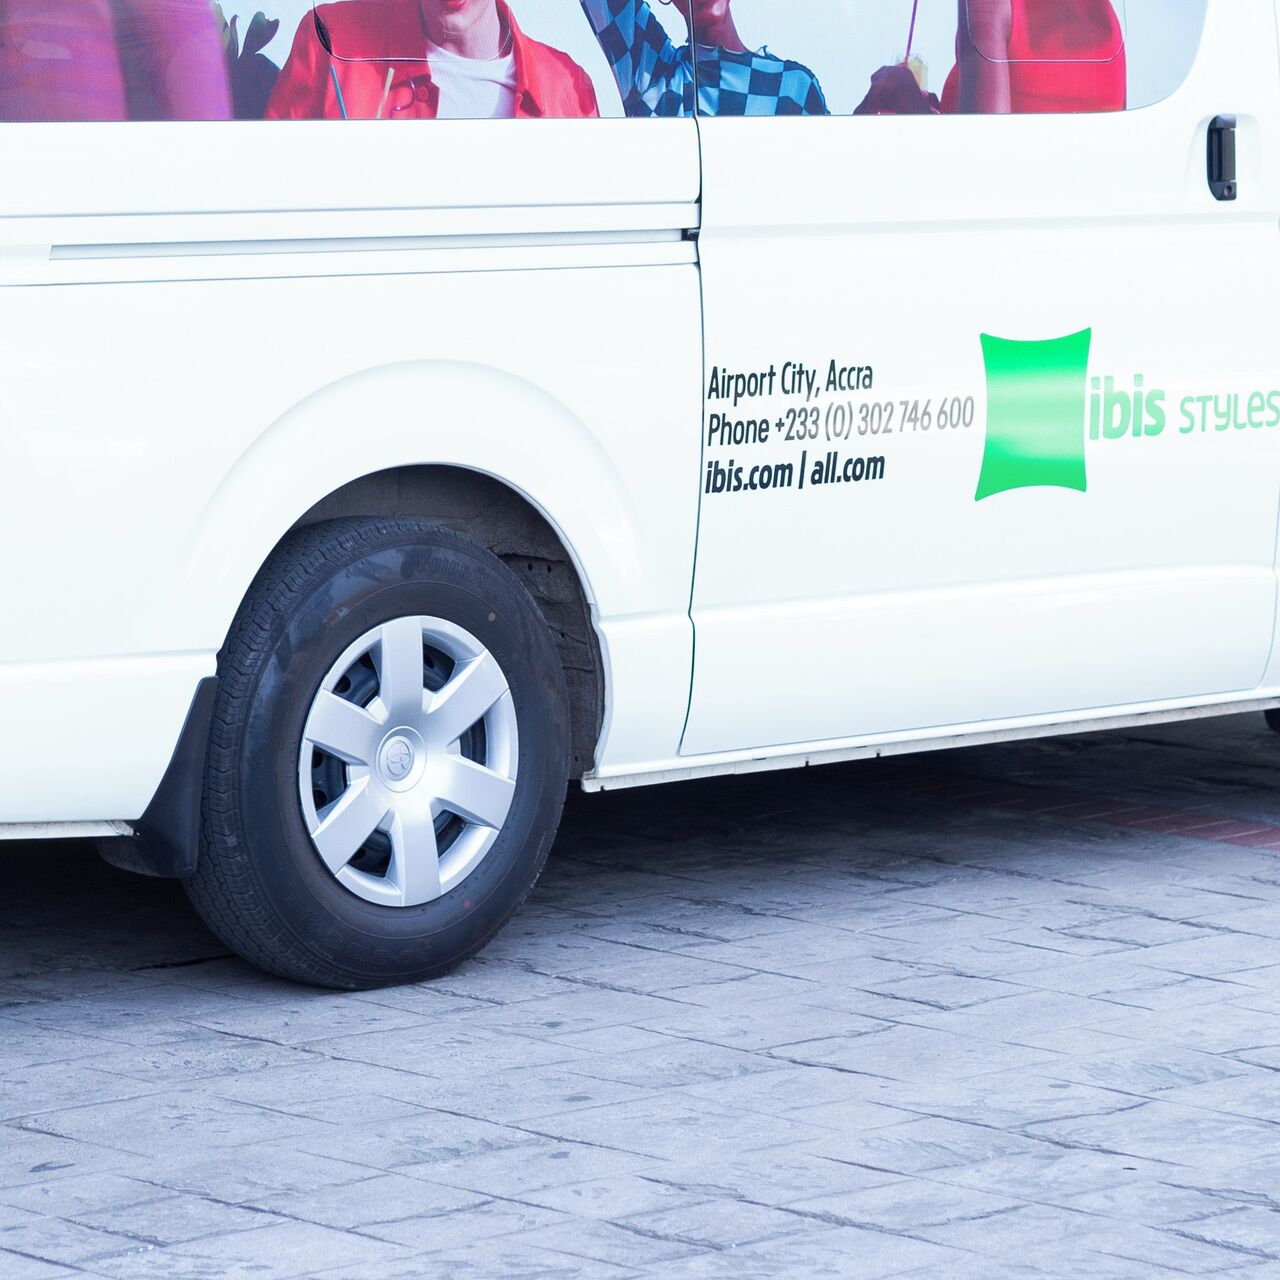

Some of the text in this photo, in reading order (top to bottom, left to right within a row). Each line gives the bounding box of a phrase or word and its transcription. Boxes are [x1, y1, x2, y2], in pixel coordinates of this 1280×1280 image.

[708, 359, 873, 407] Airport City, Accra
[1089, 373, 1166, 440] ibis
[708, 396, 975, 446] Phone +233 (0) 302 746 600
[705, 459, 793, 494] ibis.com
[810, 451, 885, 485] all.com
